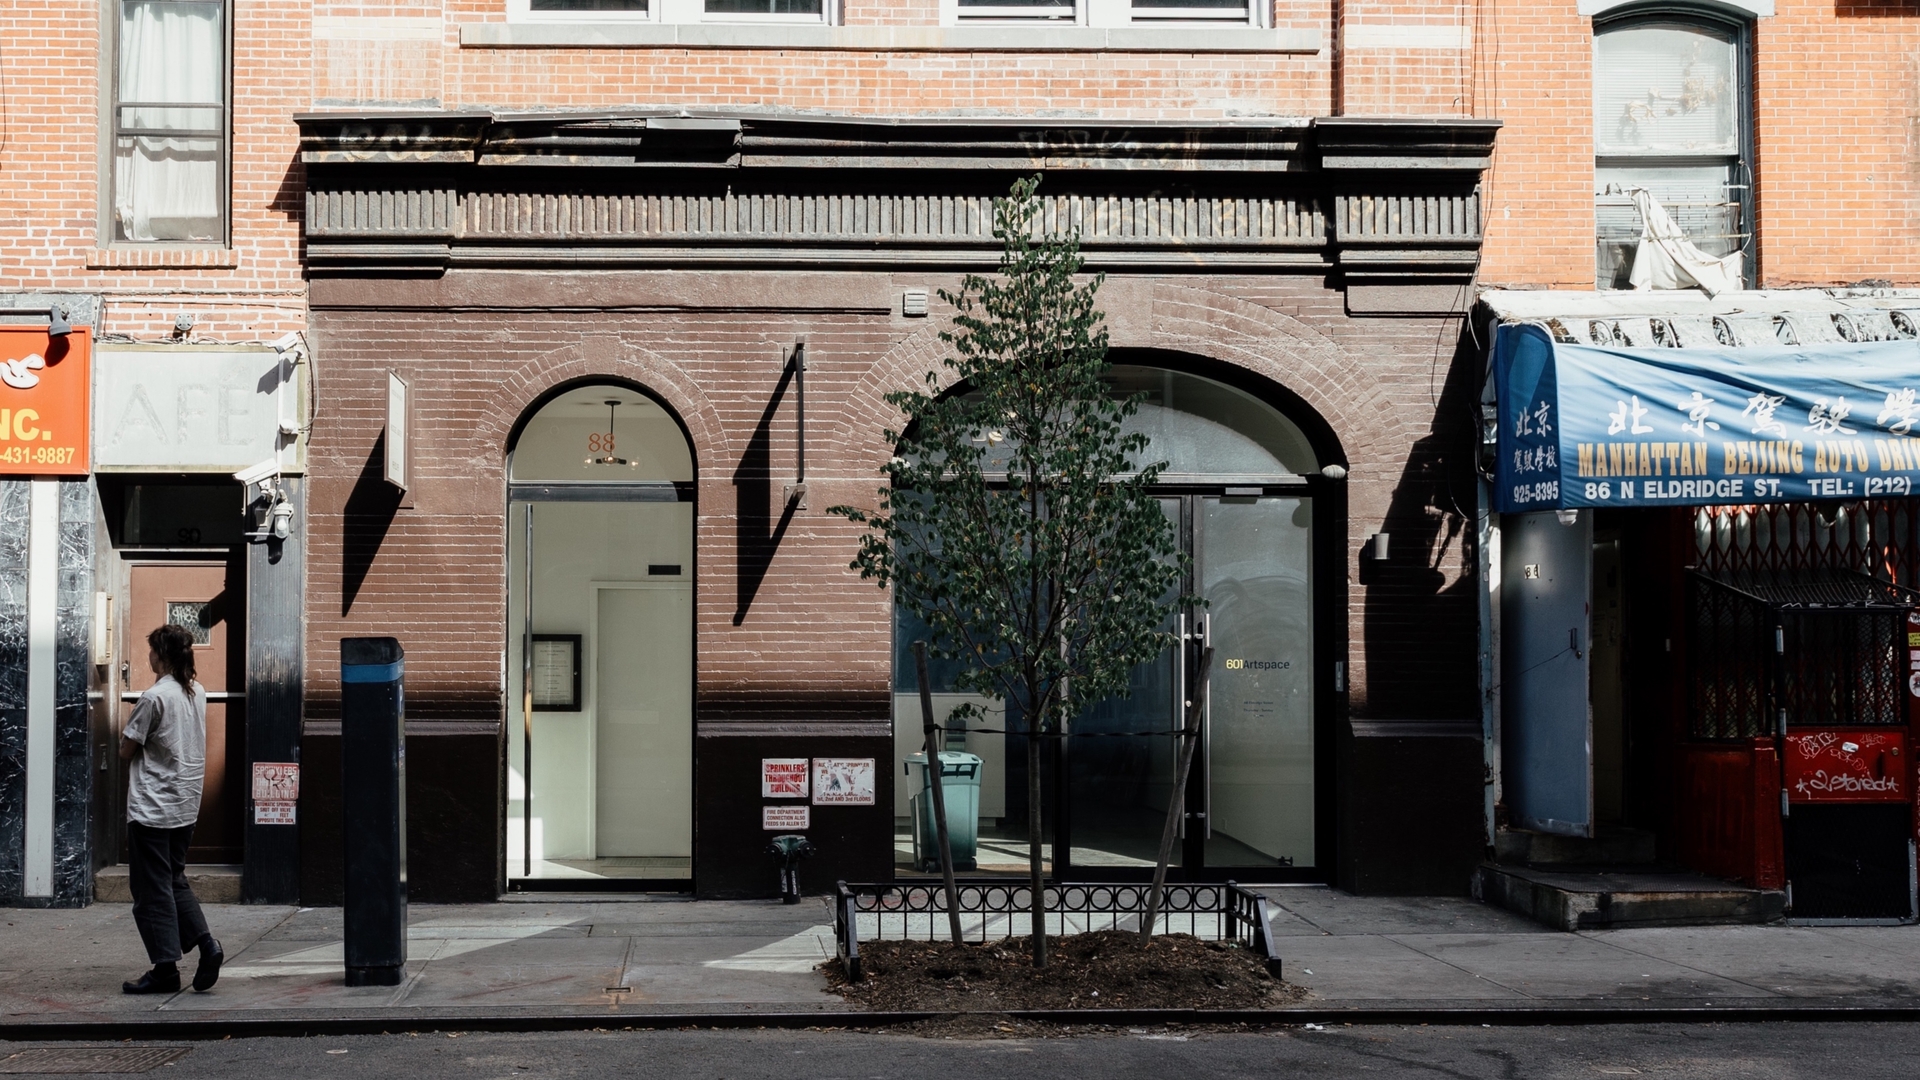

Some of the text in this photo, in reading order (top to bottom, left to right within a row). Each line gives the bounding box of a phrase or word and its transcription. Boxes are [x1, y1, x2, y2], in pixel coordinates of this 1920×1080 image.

[1515, 401, 1552, 438] 北京
[588, 433, 615, 453] 88
[1577, 442, 1708, 477] MANHATTAN
[1723, 440, 1804, 475] BEIJING
[1815, 440, 1869, 473] AUTO
[1513, 480, 1559, 503] 925-8395
[1584, 476, 1912, 499] 86 N ELDRIDGE ST. TEL: (212)
[178, 528, 201, 544] 90
[1226, 659, 1290, 671] 601Artspace
[765, 763, 805, 773] SPRINKLERS
[765, 773, 806, 783] THROUGHOUT
